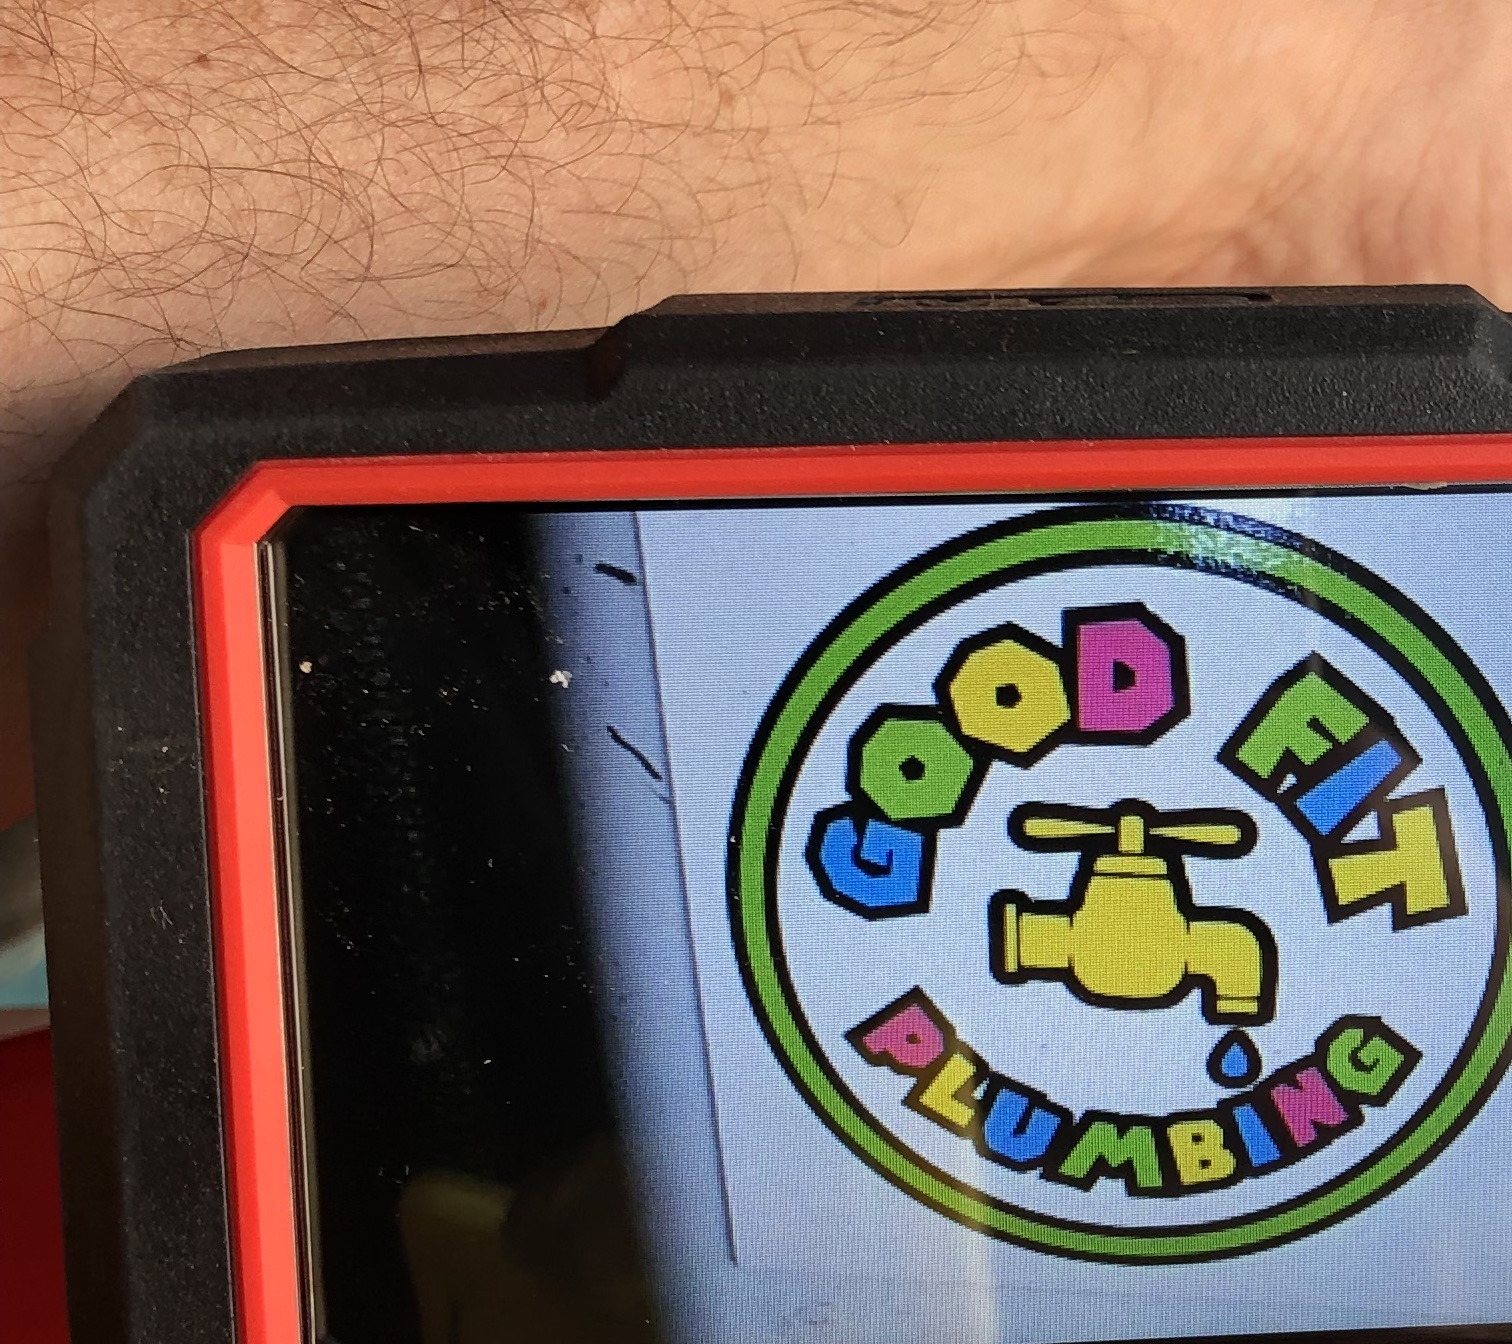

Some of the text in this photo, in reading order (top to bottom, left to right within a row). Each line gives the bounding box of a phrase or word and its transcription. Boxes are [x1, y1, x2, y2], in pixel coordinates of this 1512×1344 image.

[805, 601, 1469, 932] GOOD FIT
[843, 984, 1424, 1199] PLUMBING
